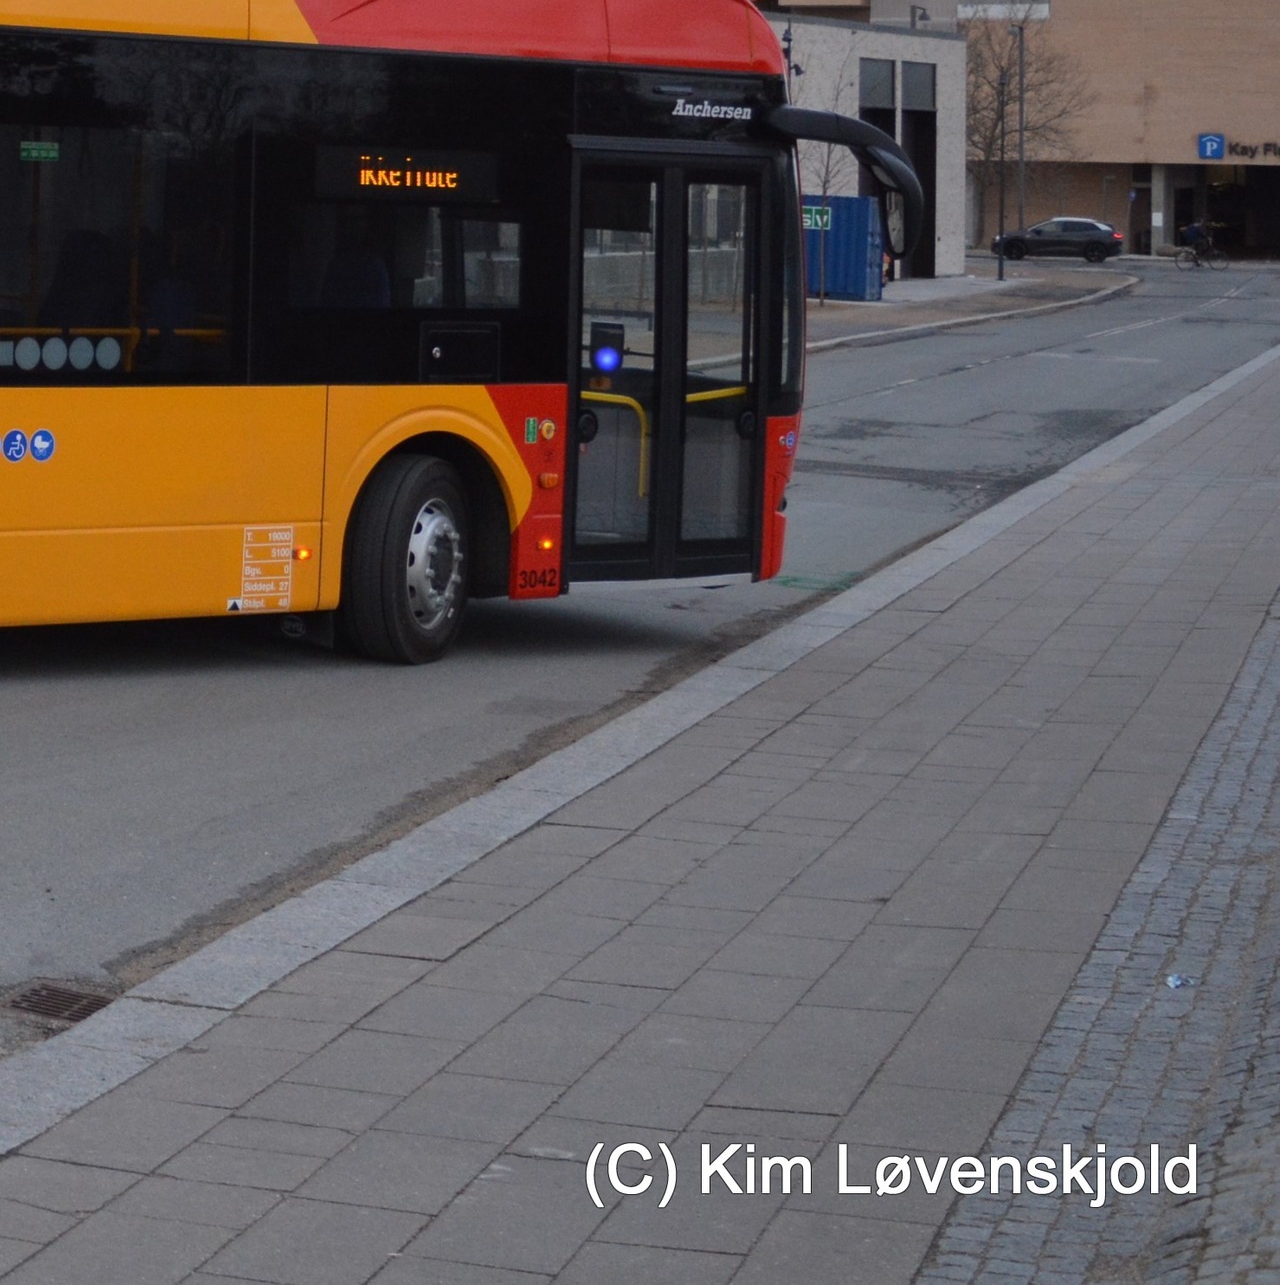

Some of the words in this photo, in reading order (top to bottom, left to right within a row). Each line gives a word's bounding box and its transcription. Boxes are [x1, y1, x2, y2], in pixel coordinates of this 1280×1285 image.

[672, 98, 752, 120] Anchersen
[1228, 142, 1259, 158] Kay
[271, 548, 290, 558] 5100
[284, 565, 289, 573] 0
[519, 568, 557, 589] 3042
[244, 582, 276, 592] Siddepl.
[279, 582, 288, 591] 27
